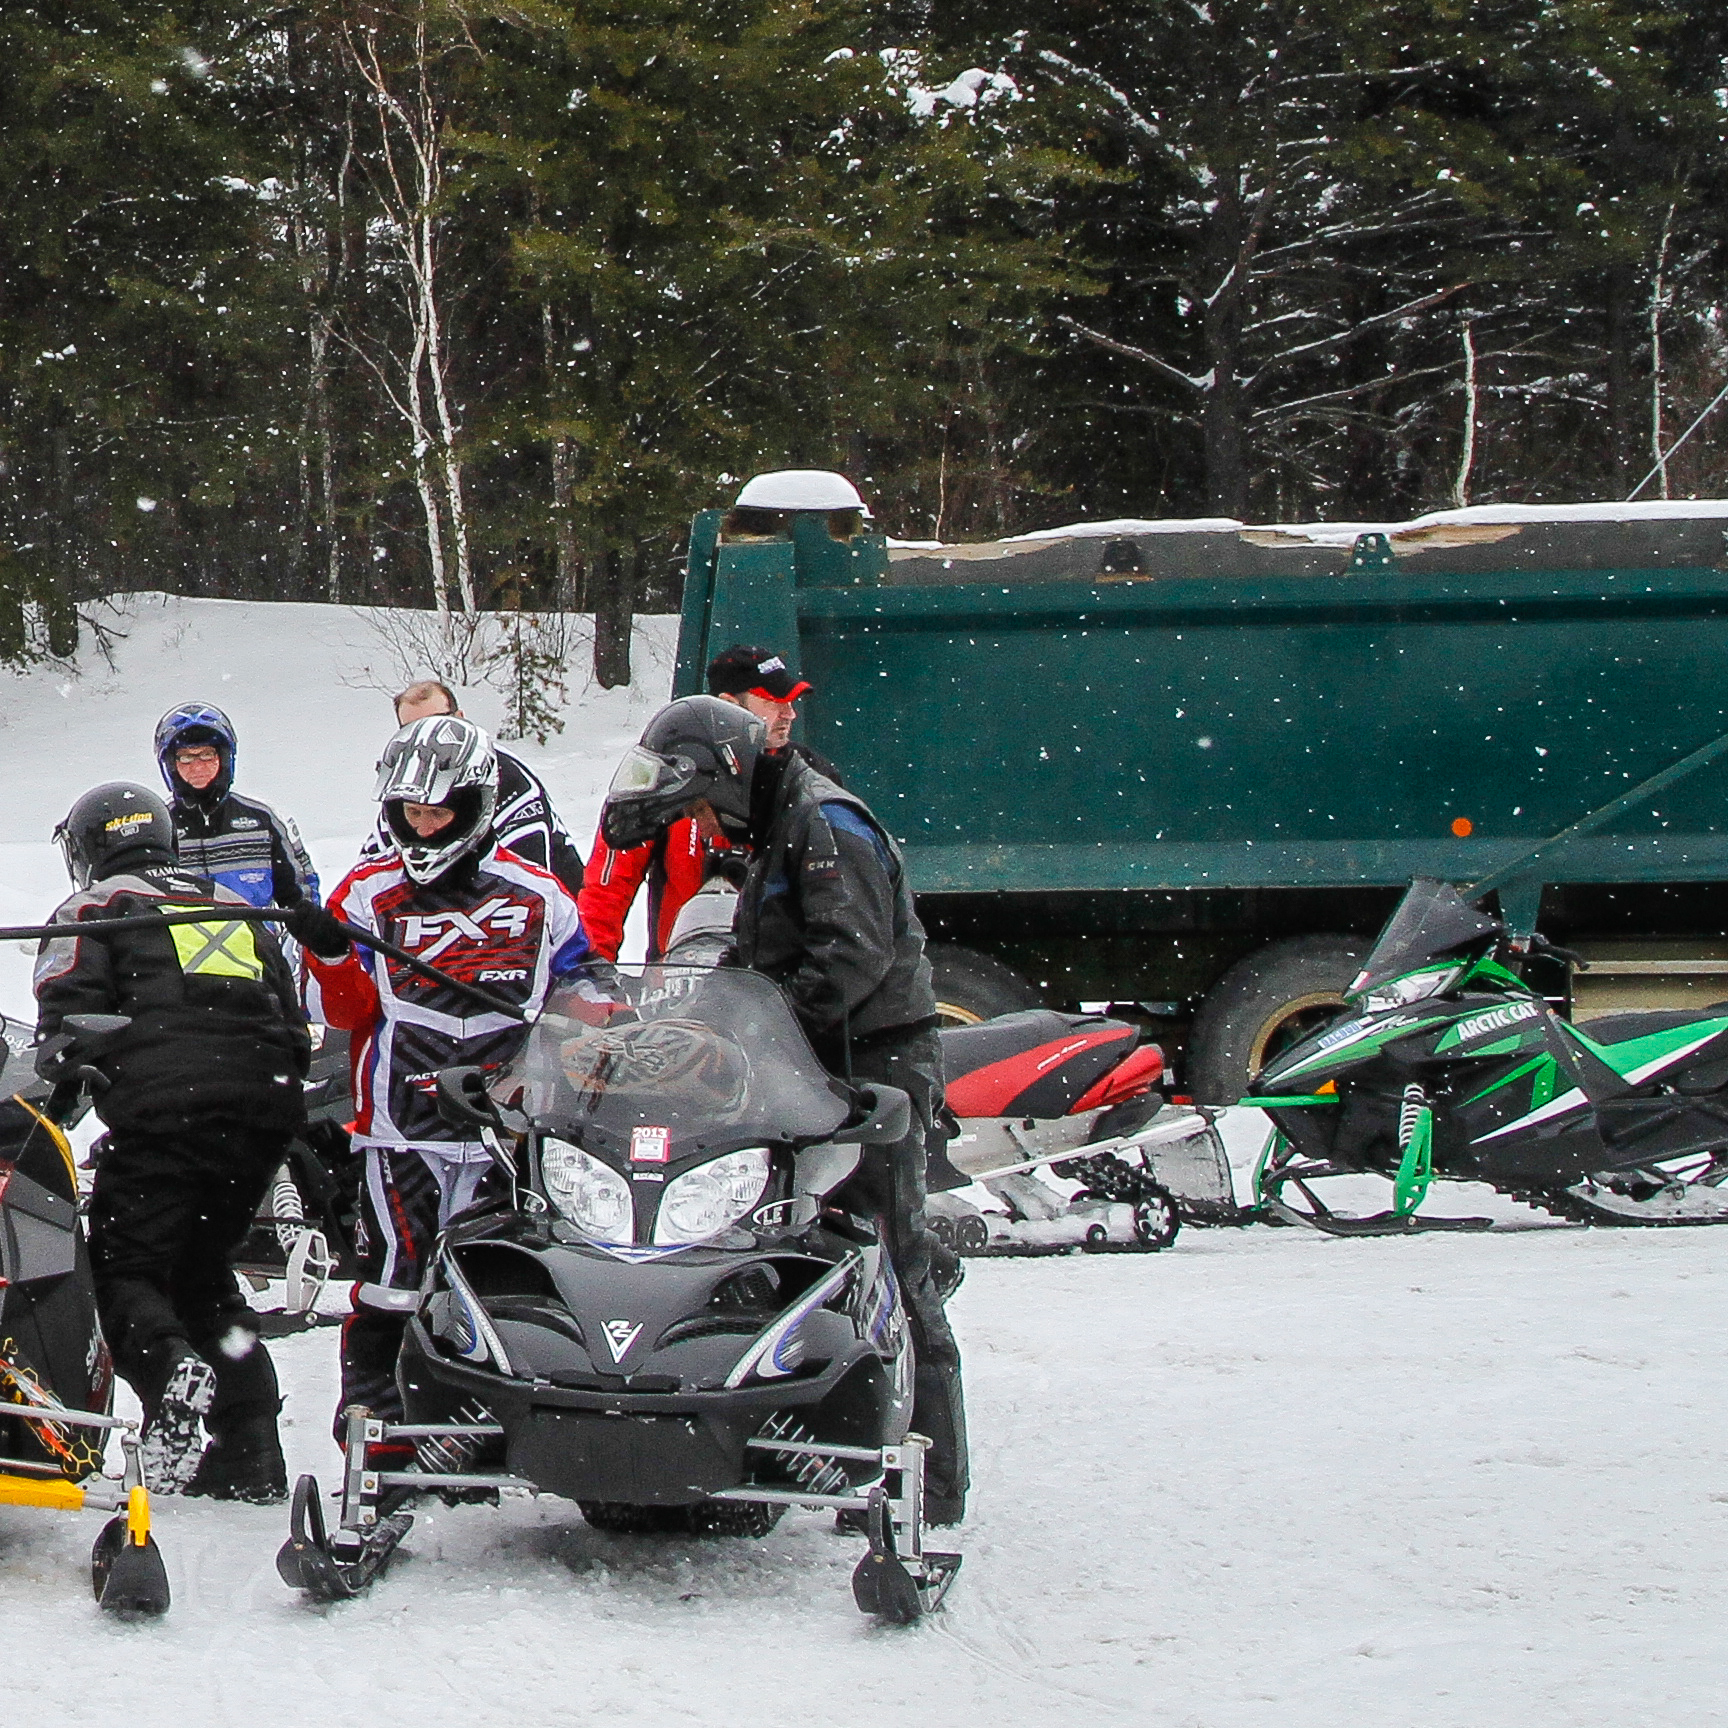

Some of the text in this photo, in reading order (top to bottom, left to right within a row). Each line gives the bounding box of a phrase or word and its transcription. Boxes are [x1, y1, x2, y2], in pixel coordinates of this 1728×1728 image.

[479, 968, 528, 982] FXR
[1456, 1000, 1539, 1041] ARCTIC CAT
[632, 1127, 668, 1139] 2013
[763, 1205, 783, 1226] LE
